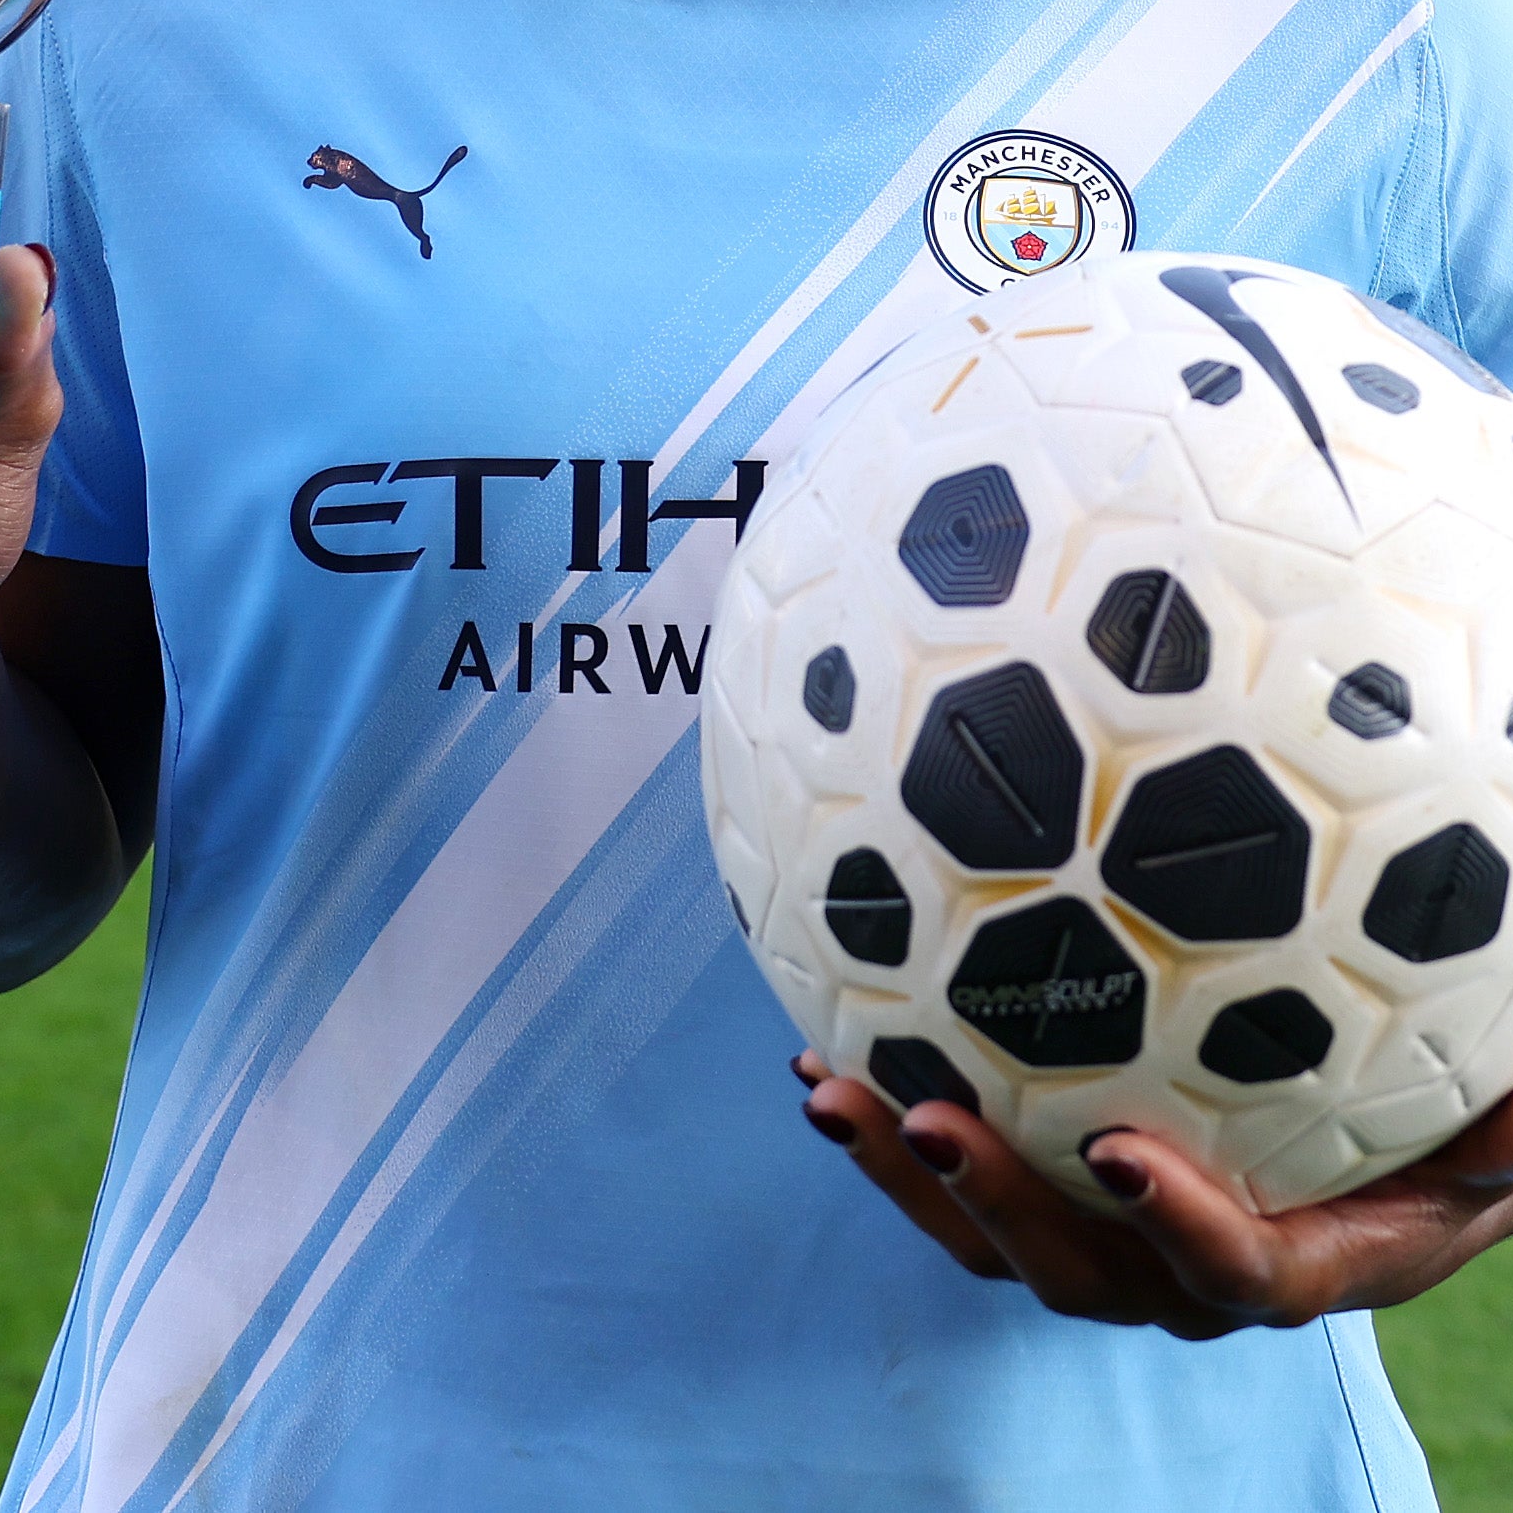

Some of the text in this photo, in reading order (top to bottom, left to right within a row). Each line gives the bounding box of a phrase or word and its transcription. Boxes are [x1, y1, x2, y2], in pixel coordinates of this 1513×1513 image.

[950, 146, 1110, 204] MANCHESTER
[943, 211, 1119, 231] 18 94
